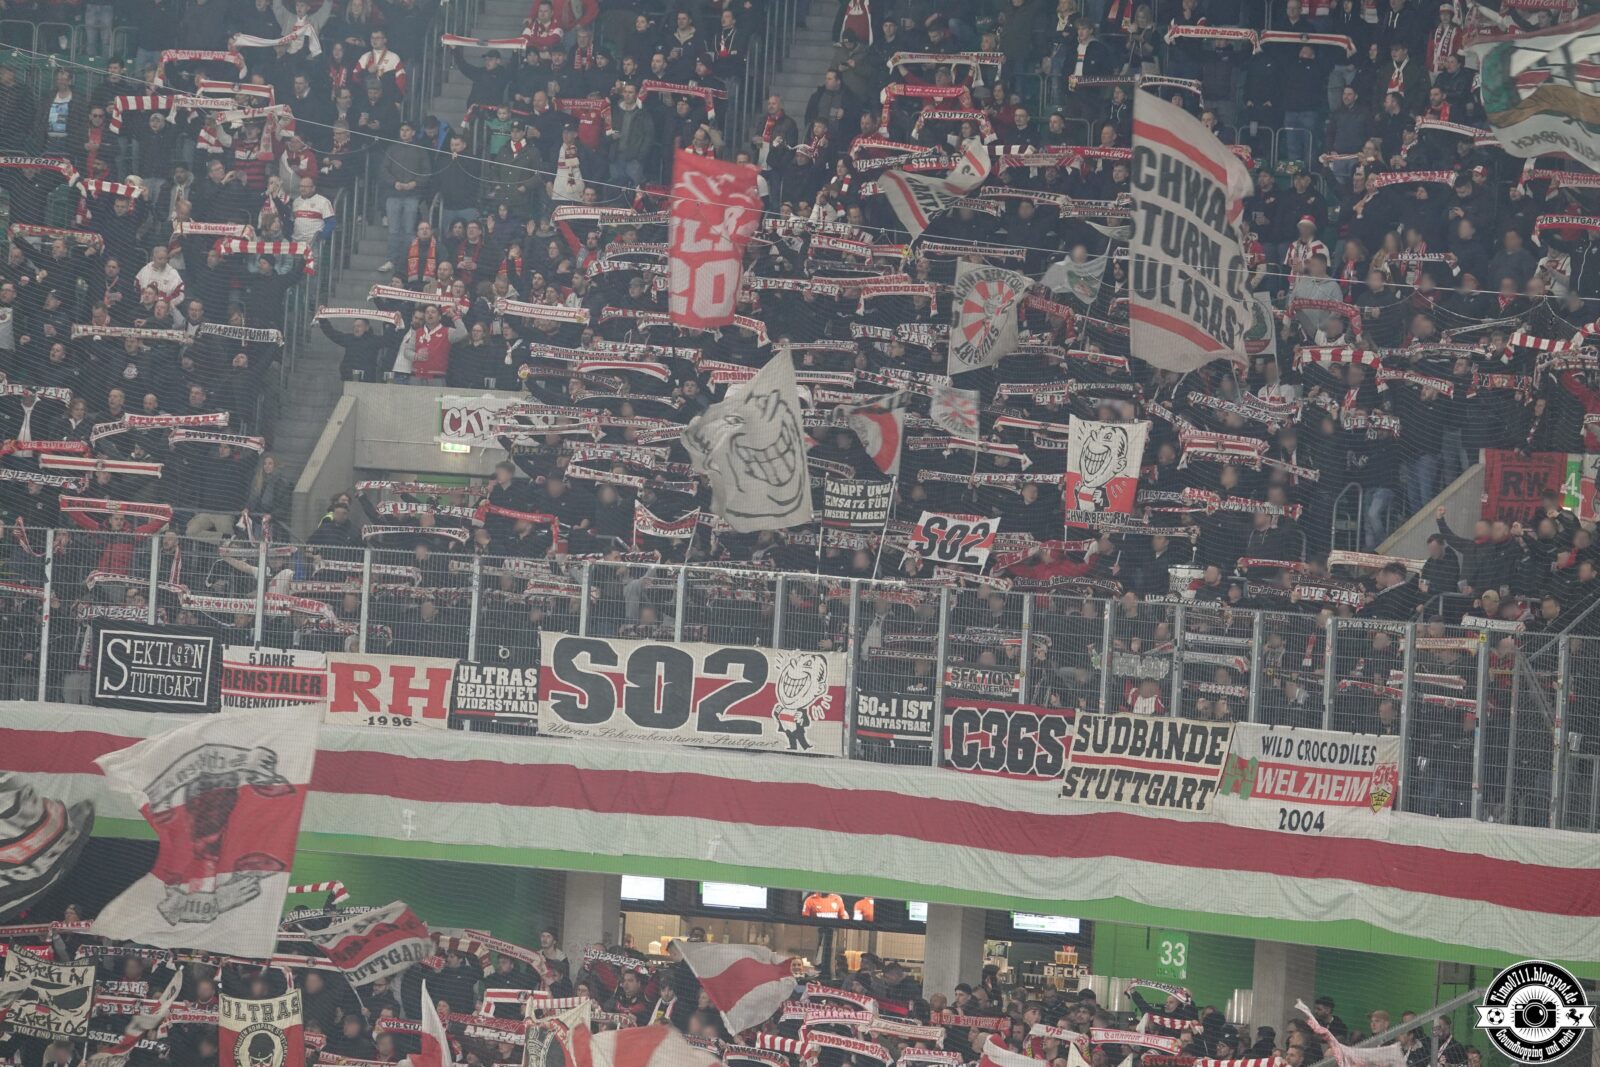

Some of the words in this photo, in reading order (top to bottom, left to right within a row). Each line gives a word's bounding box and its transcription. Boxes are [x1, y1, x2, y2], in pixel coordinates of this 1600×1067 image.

[912, 157, 937, 169] SEIT
[1555, 216, 1600, 227] STUTTGAR
[829, 237, 871, 256] Cannsta
[1134, 253, 1238, 350] ULTRAS
[868, 496, 889, 509] FÜR
[850, 510, 886, 520] FARBEN
[248, 653, 256, 666] 5
[258, 653, 295, 668] JAHRE
[460, 666, 538, 687] ULTRAS
[330, 662, 452, 720] RH
[457, 682, 538, 701] BEDEUTET
[457, 697, 538, 714] WIDERSTAND
[902, 699, 932, 720] IST
[857, 714, 931, 732] UNANTASTBAR!
[950, 706, 1067, 777] C36S
[1073, 714, 1229, 765] SÜDBANDE
[1261, 735, 1293, 758] WILD
[1297, 739, 1377, 767] CROCODILES
[1062, 766, 1217, 811] STUTTGART
[1257, 766, 1370, 802] WELZHEIM
[1278, 807, 1325, 833] 2004
[1160, 940, 1186, 967] 33
[221, 992, 300, 1022] ULTRAS
